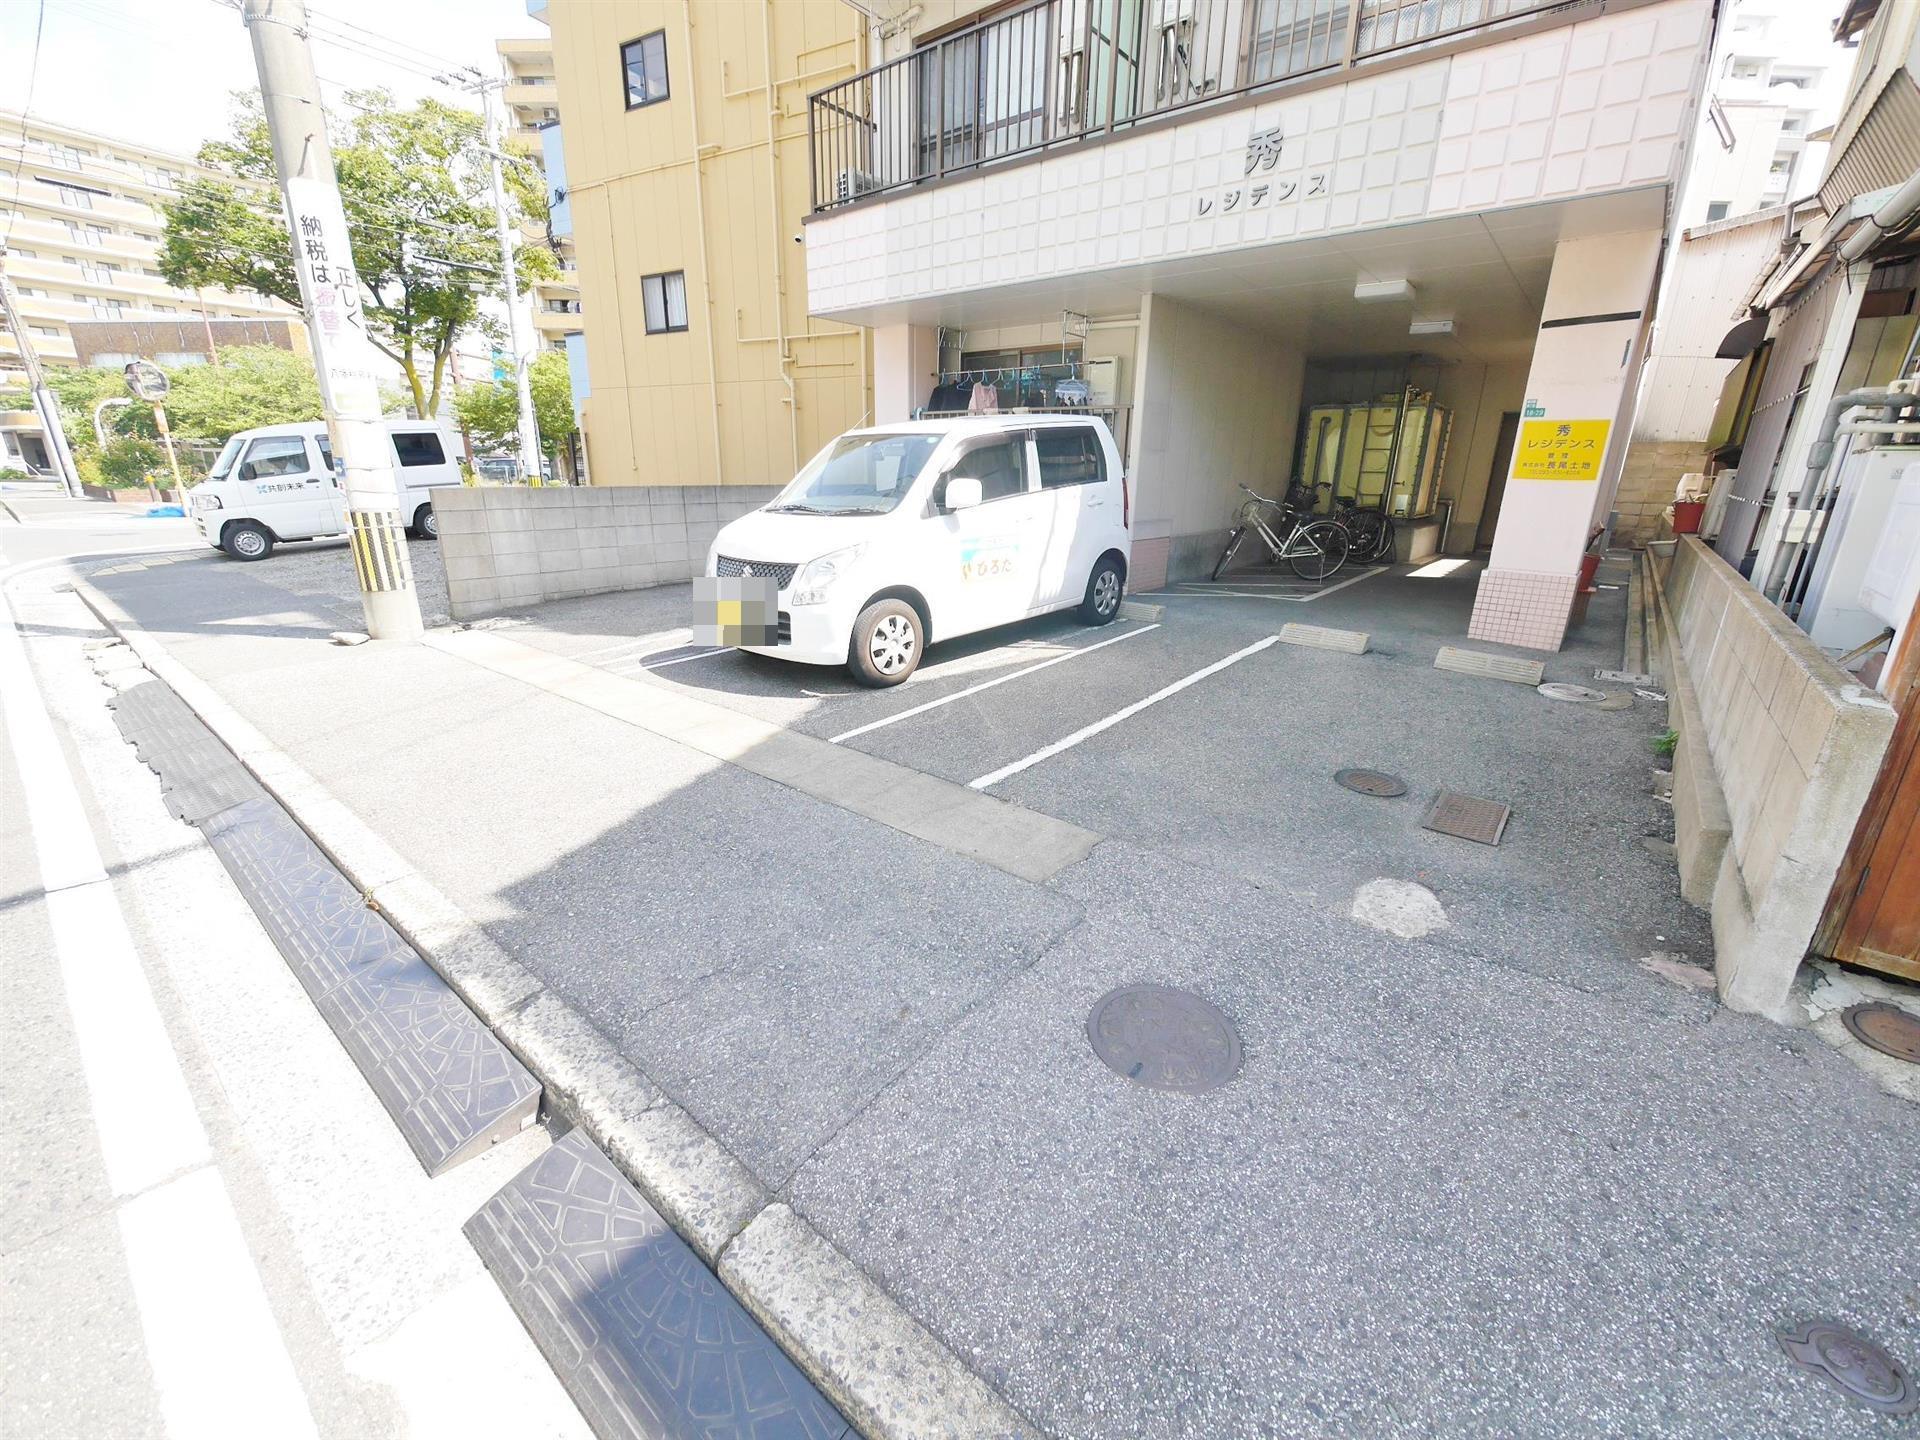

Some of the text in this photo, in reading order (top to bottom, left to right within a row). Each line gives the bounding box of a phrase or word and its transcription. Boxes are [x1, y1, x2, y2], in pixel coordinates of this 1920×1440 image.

[1245, 127, 1283, 174] 秀
[1199, 175, 1325, 215] レジデンス
[1556, 424, 1571, 436] 秀
[1528, 439, 1595, 449] レジデンス
